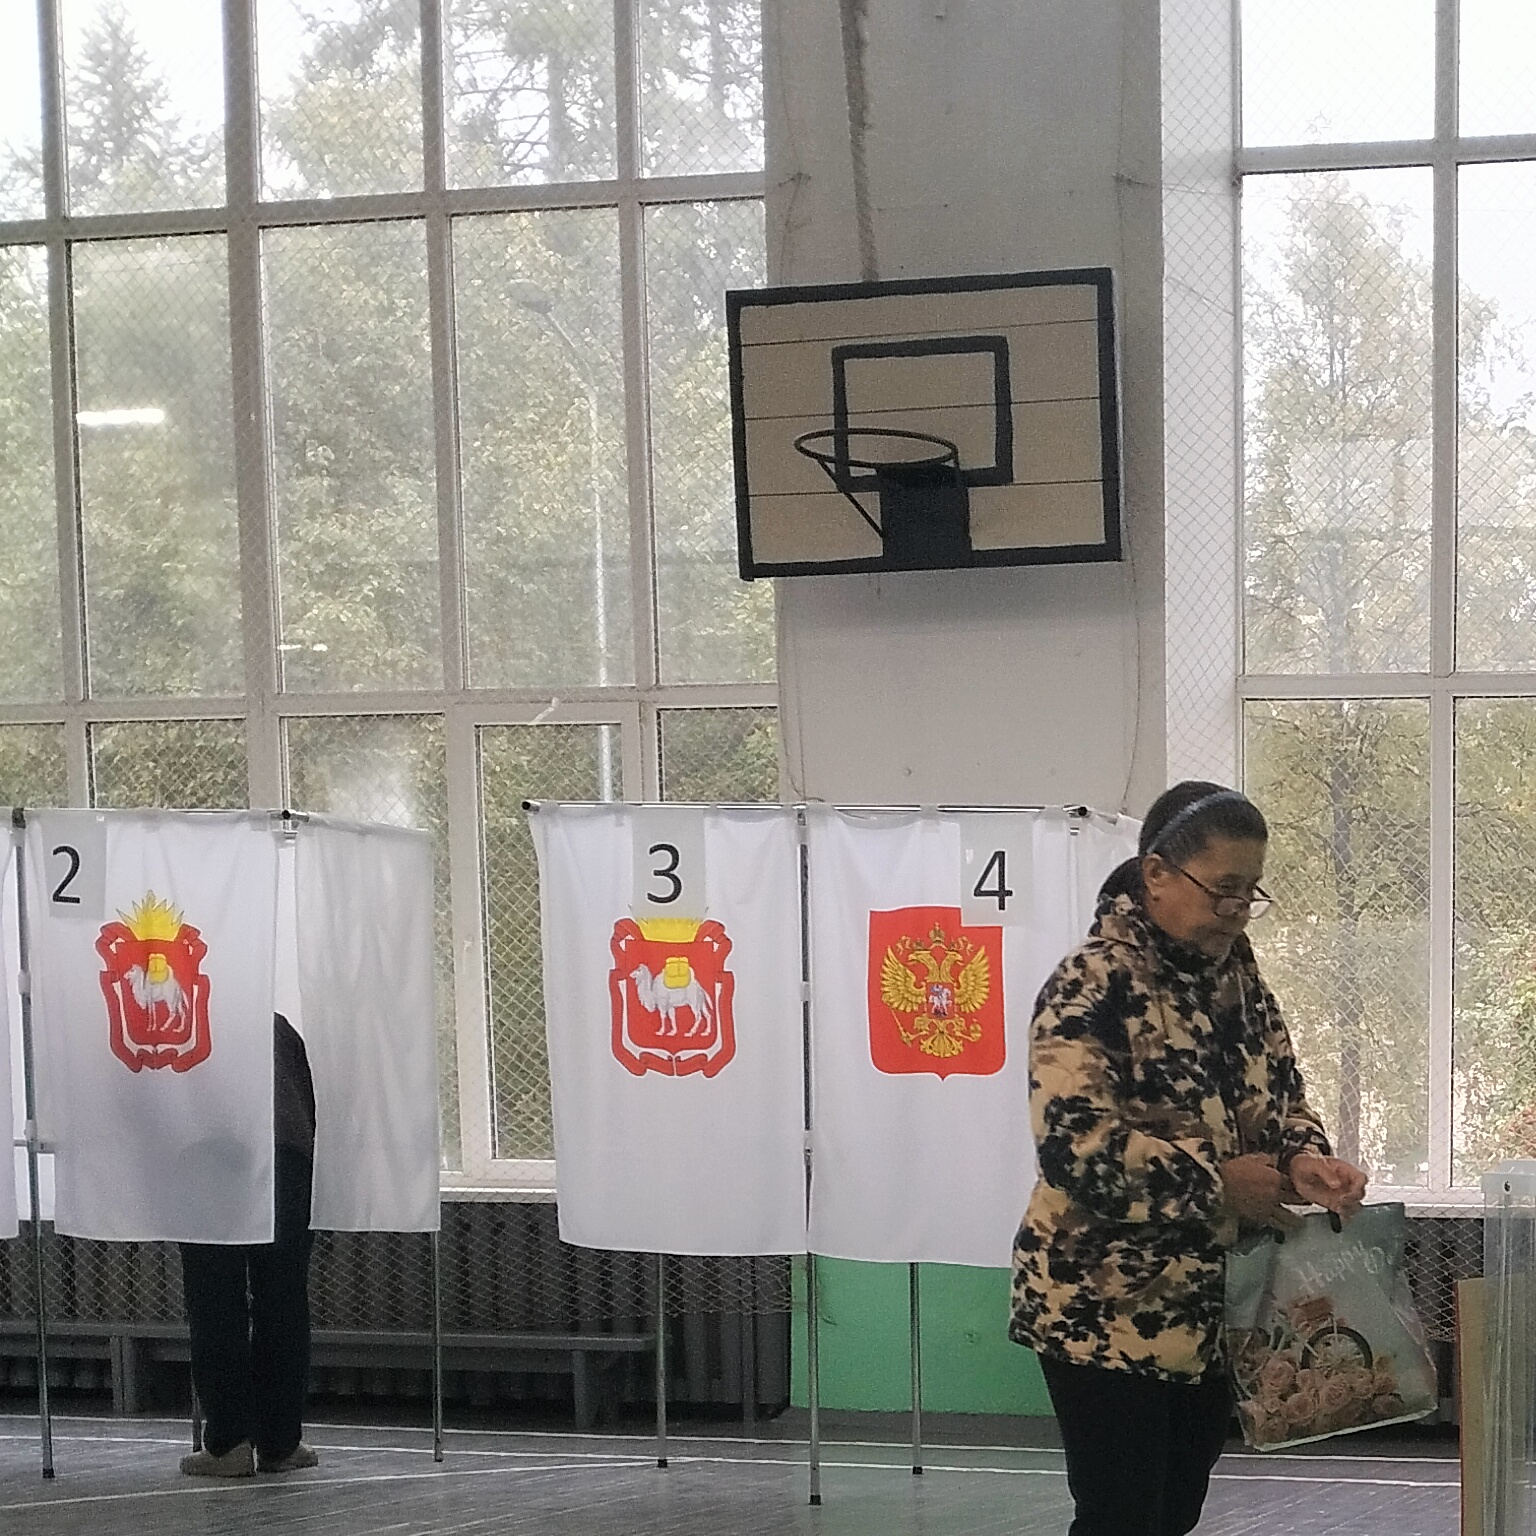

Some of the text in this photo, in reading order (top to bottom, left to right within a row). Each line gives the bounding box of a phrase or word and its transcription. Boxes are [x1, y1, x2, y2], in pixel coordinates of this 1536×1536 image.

[53, 846, 80, 904] 2
[647, 844, 682, 903] 3
[974, 851, 1013, 910] 4
